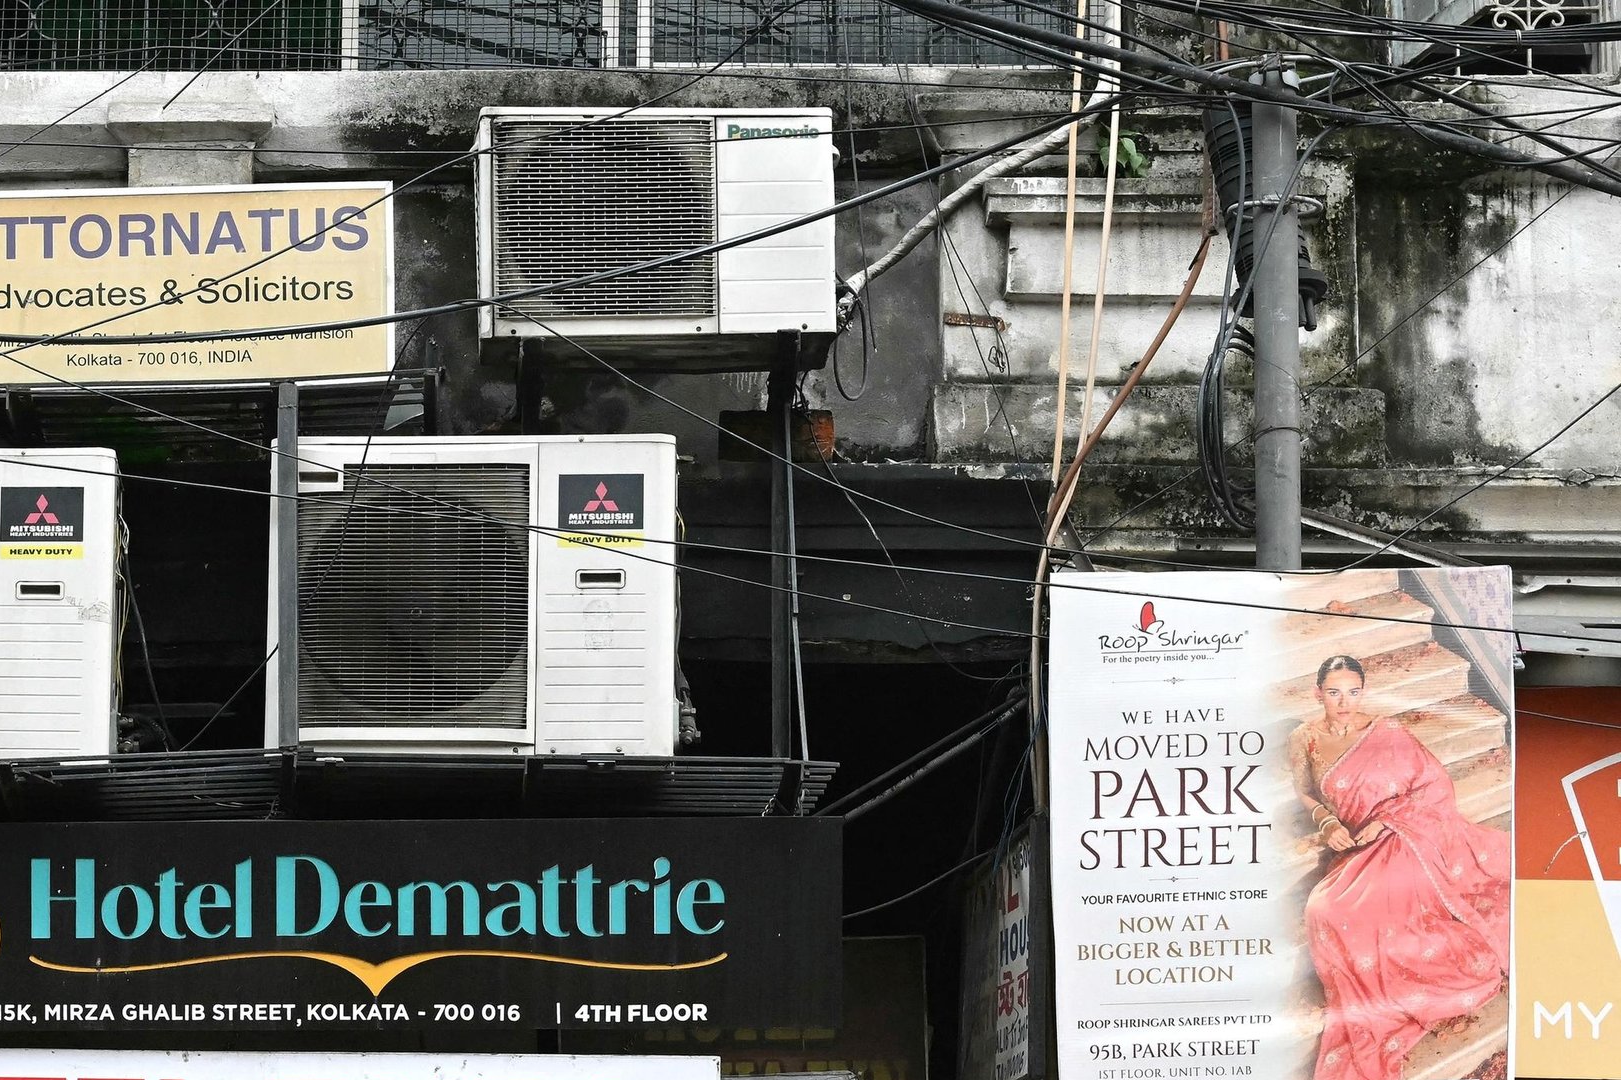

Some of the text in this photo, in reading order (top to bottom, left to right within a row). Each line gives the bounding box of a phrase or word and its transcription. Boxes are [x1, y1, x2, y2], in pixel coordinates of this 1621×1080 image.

[727, 124, 820, 139] Panasonic
[160, 279, 184, 305] &
[196, 276, 355, 304] Solicitors
[66, 348, 253, 367] Kolkata 700 016, INDIA
[1158, 630, 1244, 653] Shringar
[1103, 653, 1188, 664] For the poetry inside
[1121, 707, 1227, 725] WE HAVE
[1083, 730, 1265, 762] MOVED TO
[1089, 765, 1264, 820] PARK
[1079, 823, 1272, 871] STREET
[30, 854, 253, 940] Hotel
[276, 855, 726, 938] Demattrie
[1081, 889, 1268, 905] YOUR FAVOURITE ETHNIC STORE
[1119, 914, 1230, 934] NOW AT A
[1077, 938, 1274, 961] BIGGER & BETTER
[1115, 965, 1233, 985] LOCATION
[44, 1003, 115, 1021] MIRZA
[122, 1003, 206, 1021] GHALIB
[212, 1003, 302, 1027] STREET,
[307, 1004, 410, 1021] KOLKATA
[433, 1003, 476, 1021] 700
[481, 1003, 521, 1022] 016
[574, 1003, 622, 1023] 4TH
[627, 1002, 708, 1022] FLOOR
[1077, 1014, 1272, 1030] ROOP SHRINGAR SAREES PVT LTD
[1532, 1001, 1614, 1040] MY
[1089, 1039, 1261, 1062] 95B, PARK STREET
[1120, 1067, 1166, 1079] FLOOR,
[1169, 1067, 1201, 1078] UNIT
[1205, 1066, 1228, 1077] NO.
